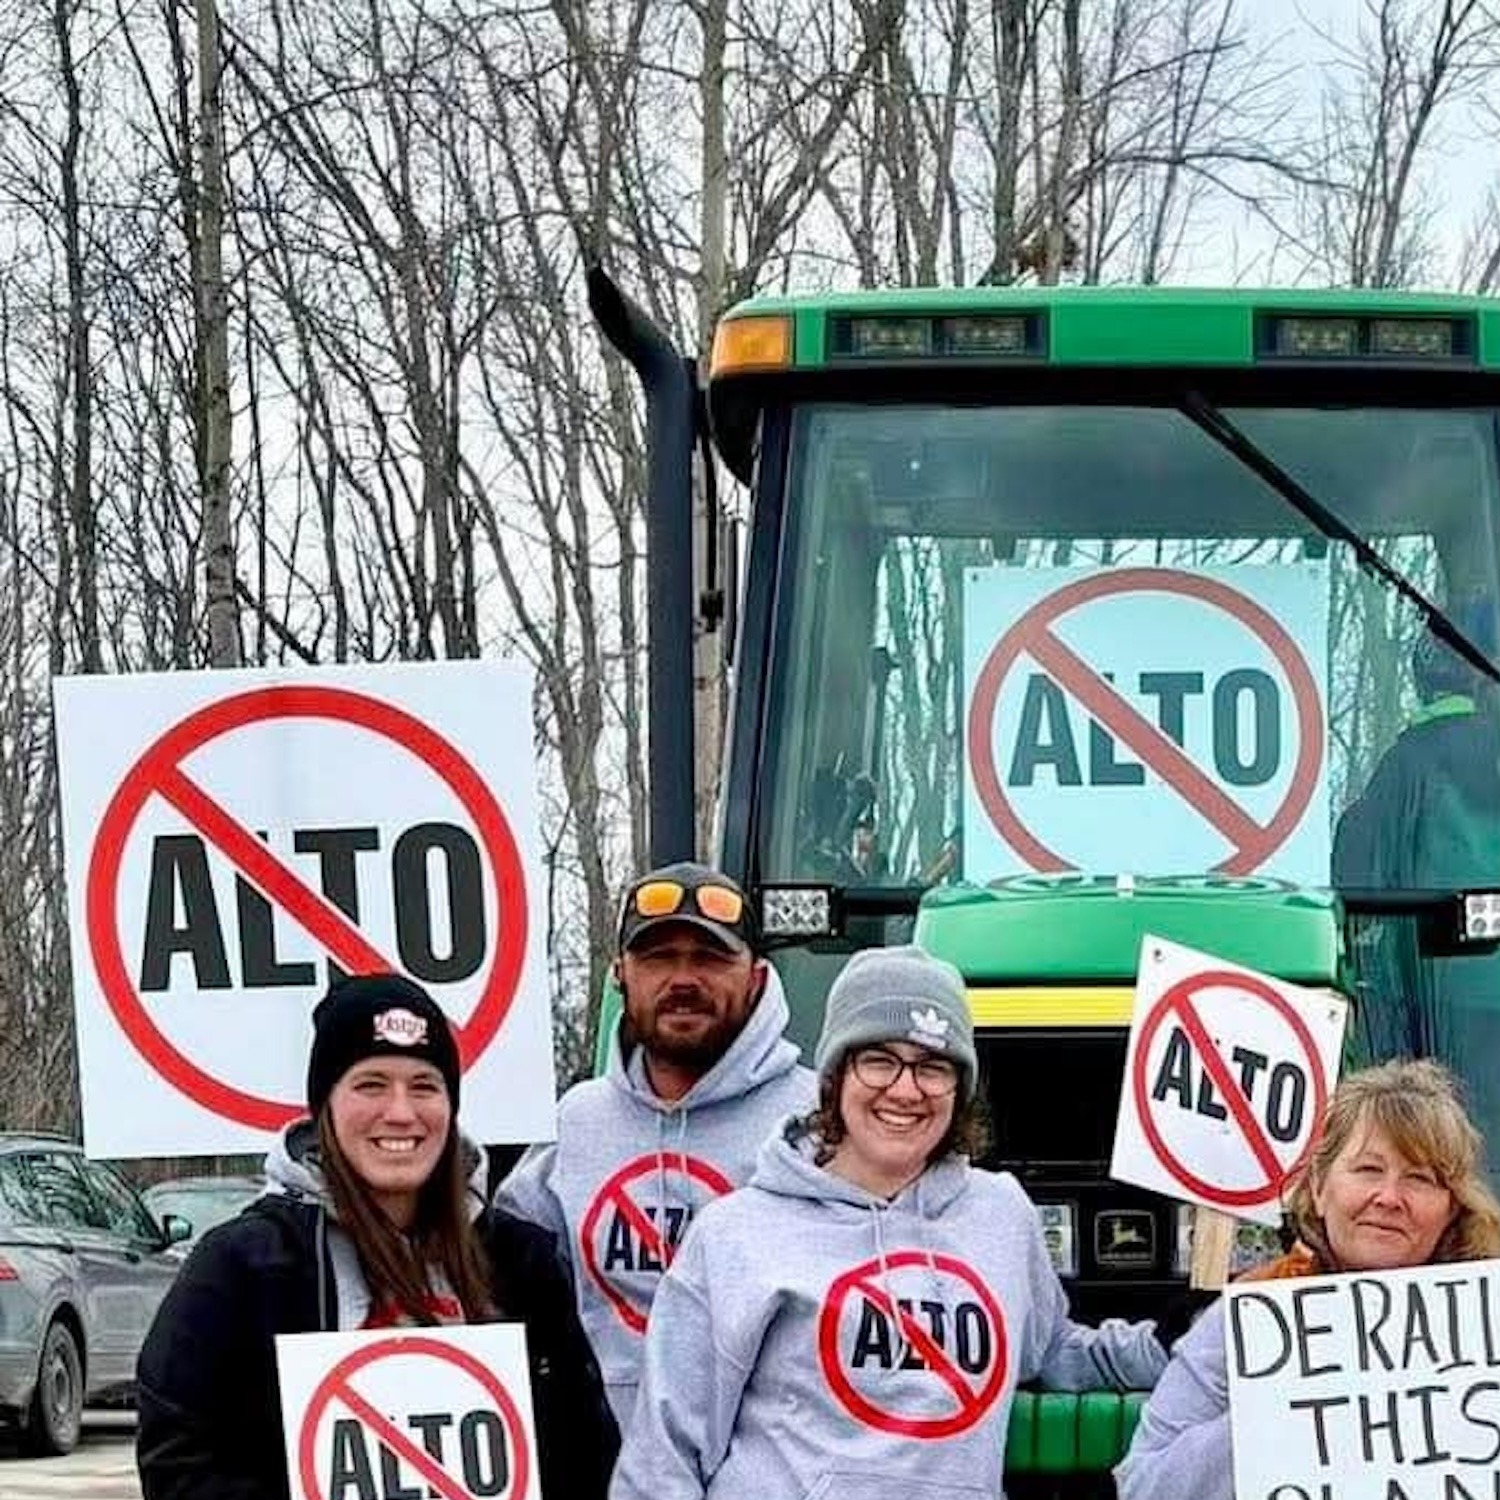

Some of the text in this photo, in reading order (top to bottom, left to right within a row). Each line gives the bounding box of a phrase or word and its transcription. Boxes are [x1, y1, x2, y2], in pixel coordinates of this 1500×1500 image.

[1009, 667, 1280, 788] ALTO
[140, 822, 486, 992] ALTO
[1152, 1026, 1306, 1142] ALTO
[852, 1298, 991, 1375] ALTO
